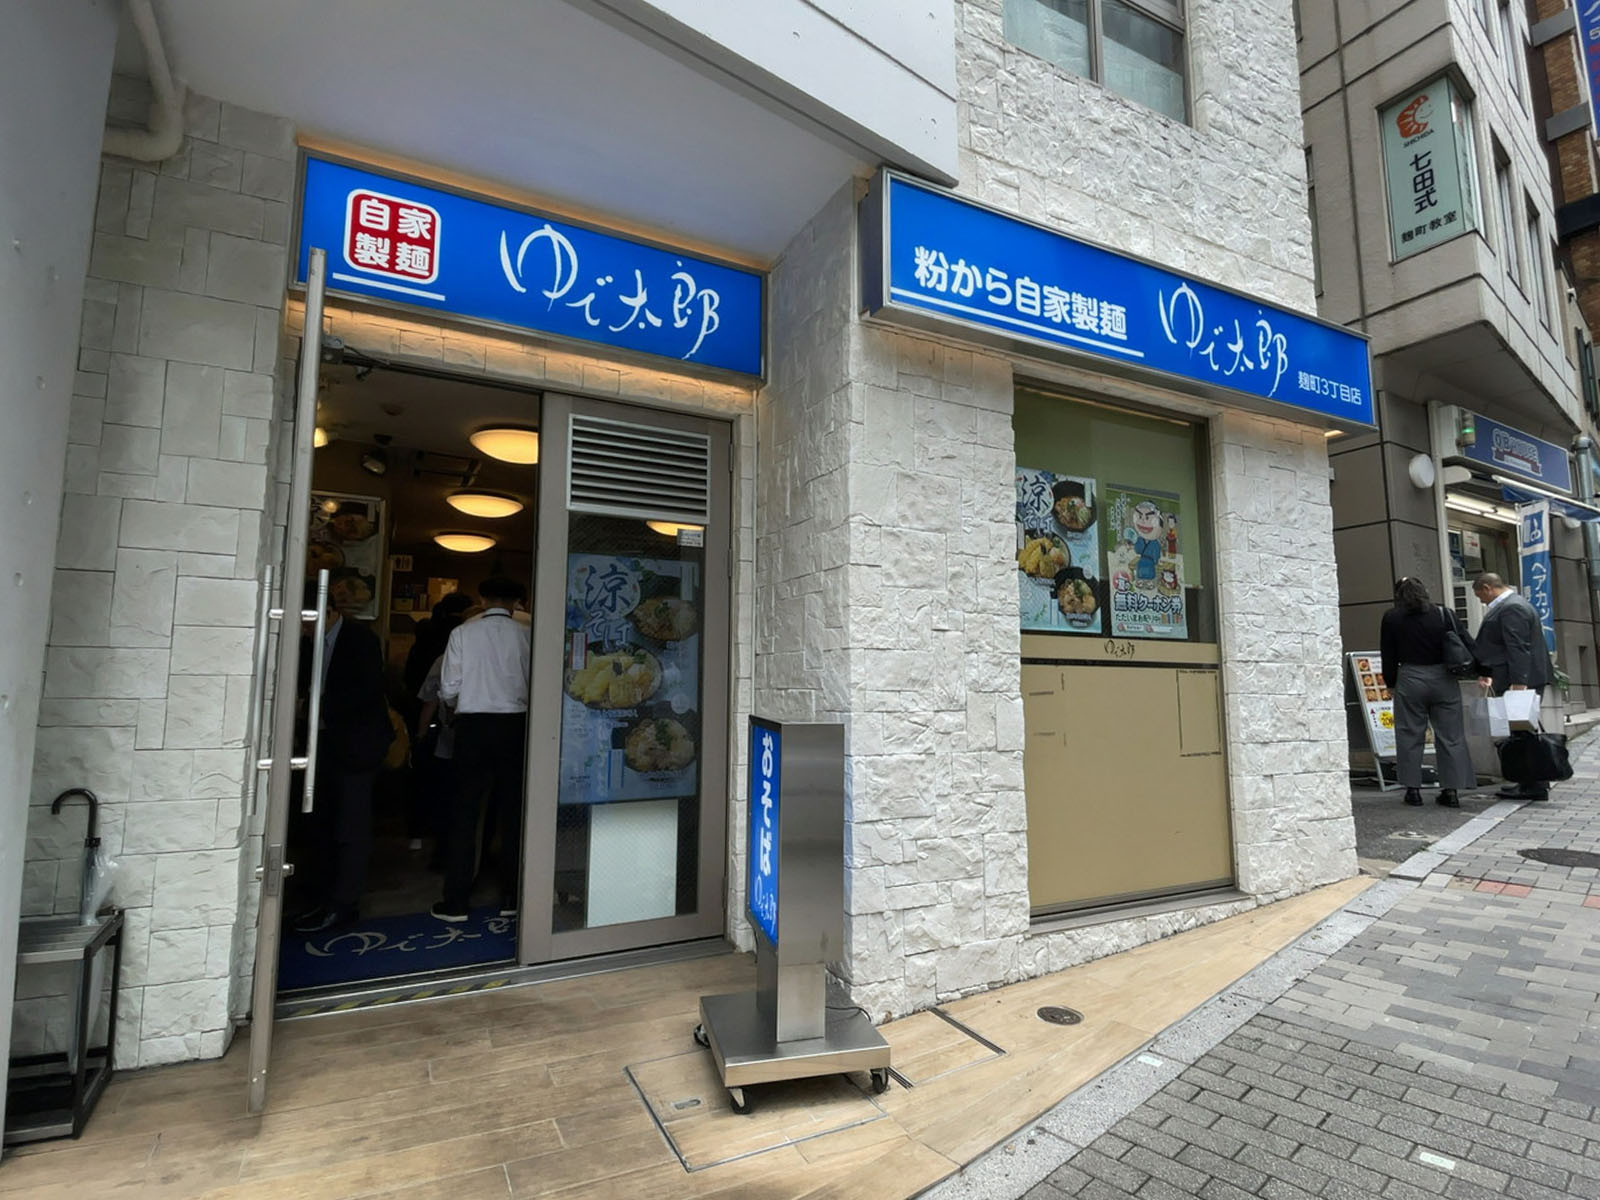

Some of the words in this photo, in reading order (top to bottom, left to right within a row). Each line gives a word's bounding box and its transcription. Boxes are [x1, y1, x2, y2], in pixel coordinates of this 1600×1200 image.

[358, 199, 432, 241] 自家
[1410, 151, 1438, 214] 七田式
[354, 231, 431, 278] 製麺
[500, 223, 720, 360] ゆで太郎
[914, 245, 1128, 342] 粉から自家製麺
[1159, 281, 1288, 398] ゆで太郎
